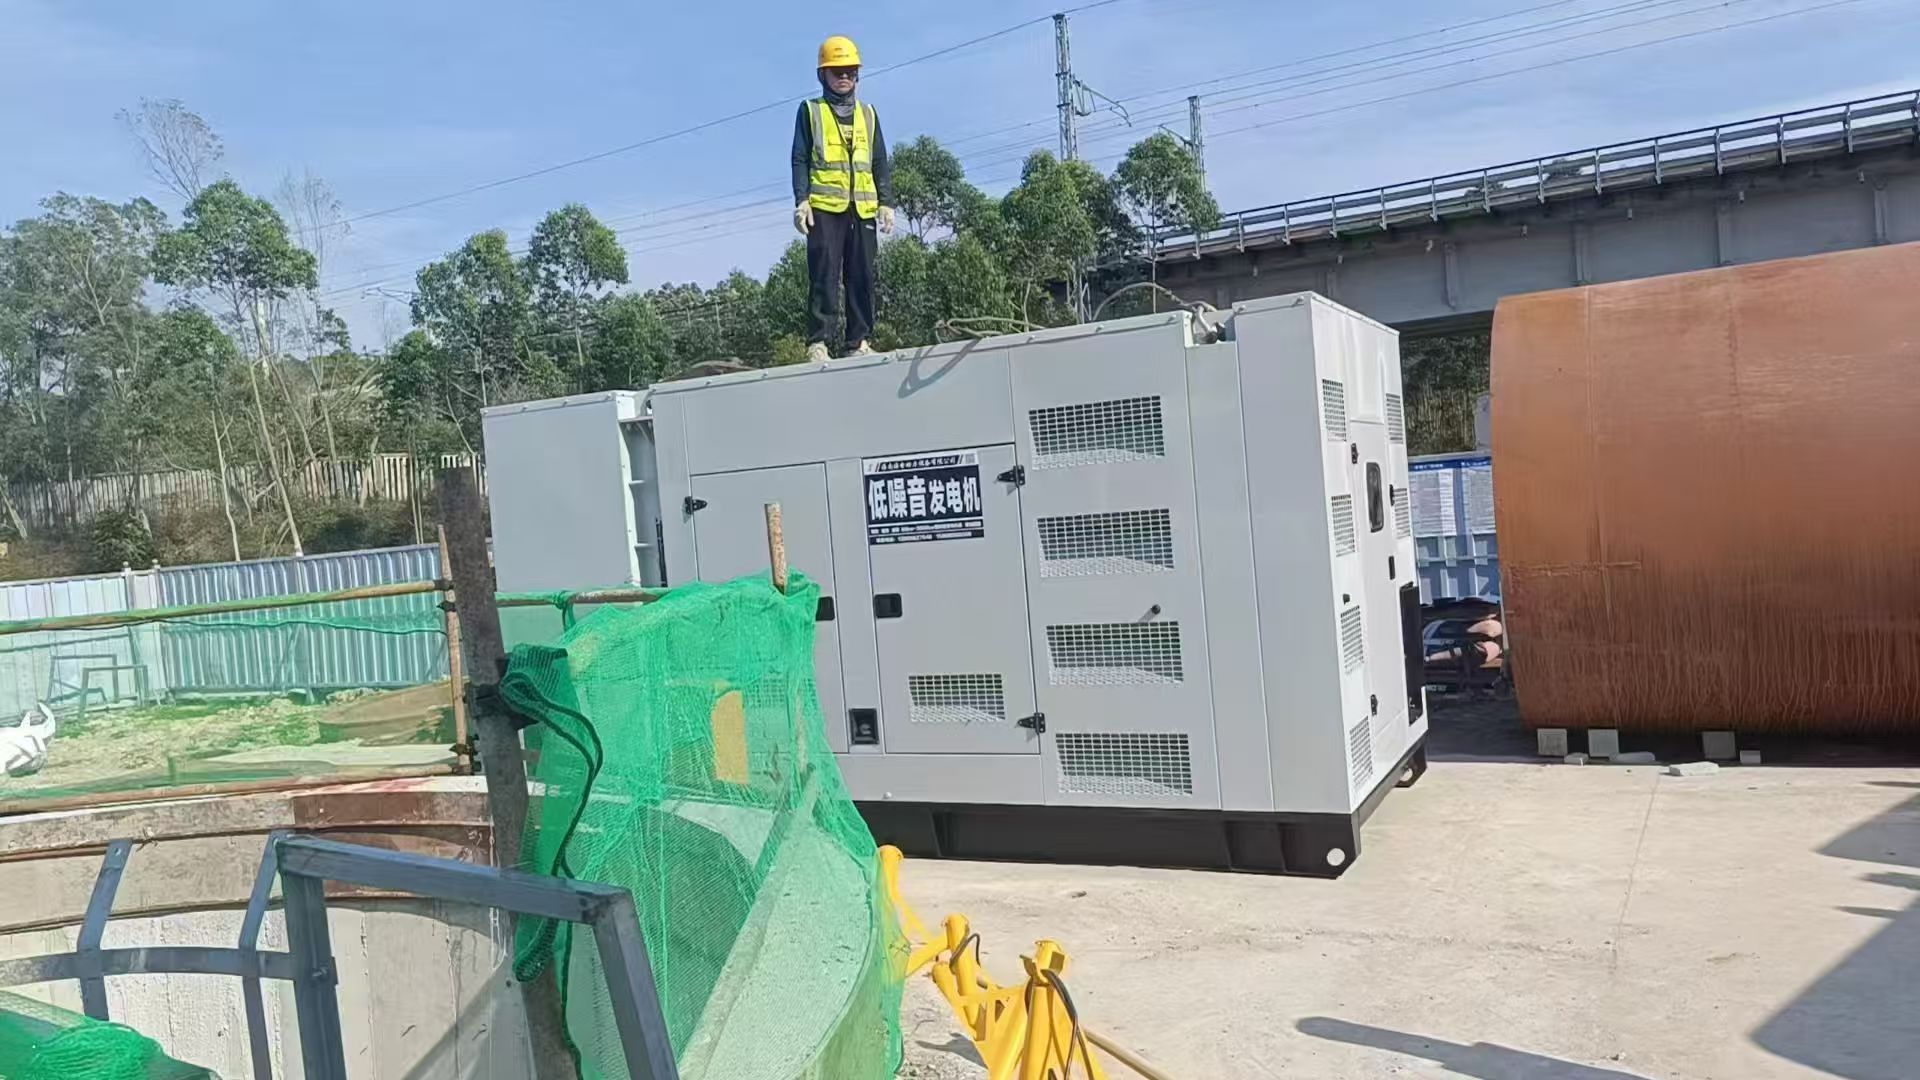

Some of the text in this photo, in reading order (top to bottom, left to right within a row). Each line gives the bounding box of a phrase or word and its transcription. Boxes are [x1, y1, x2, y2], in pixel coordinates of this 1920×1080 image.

[868, 475, 981, 520] 低噪音发电机
